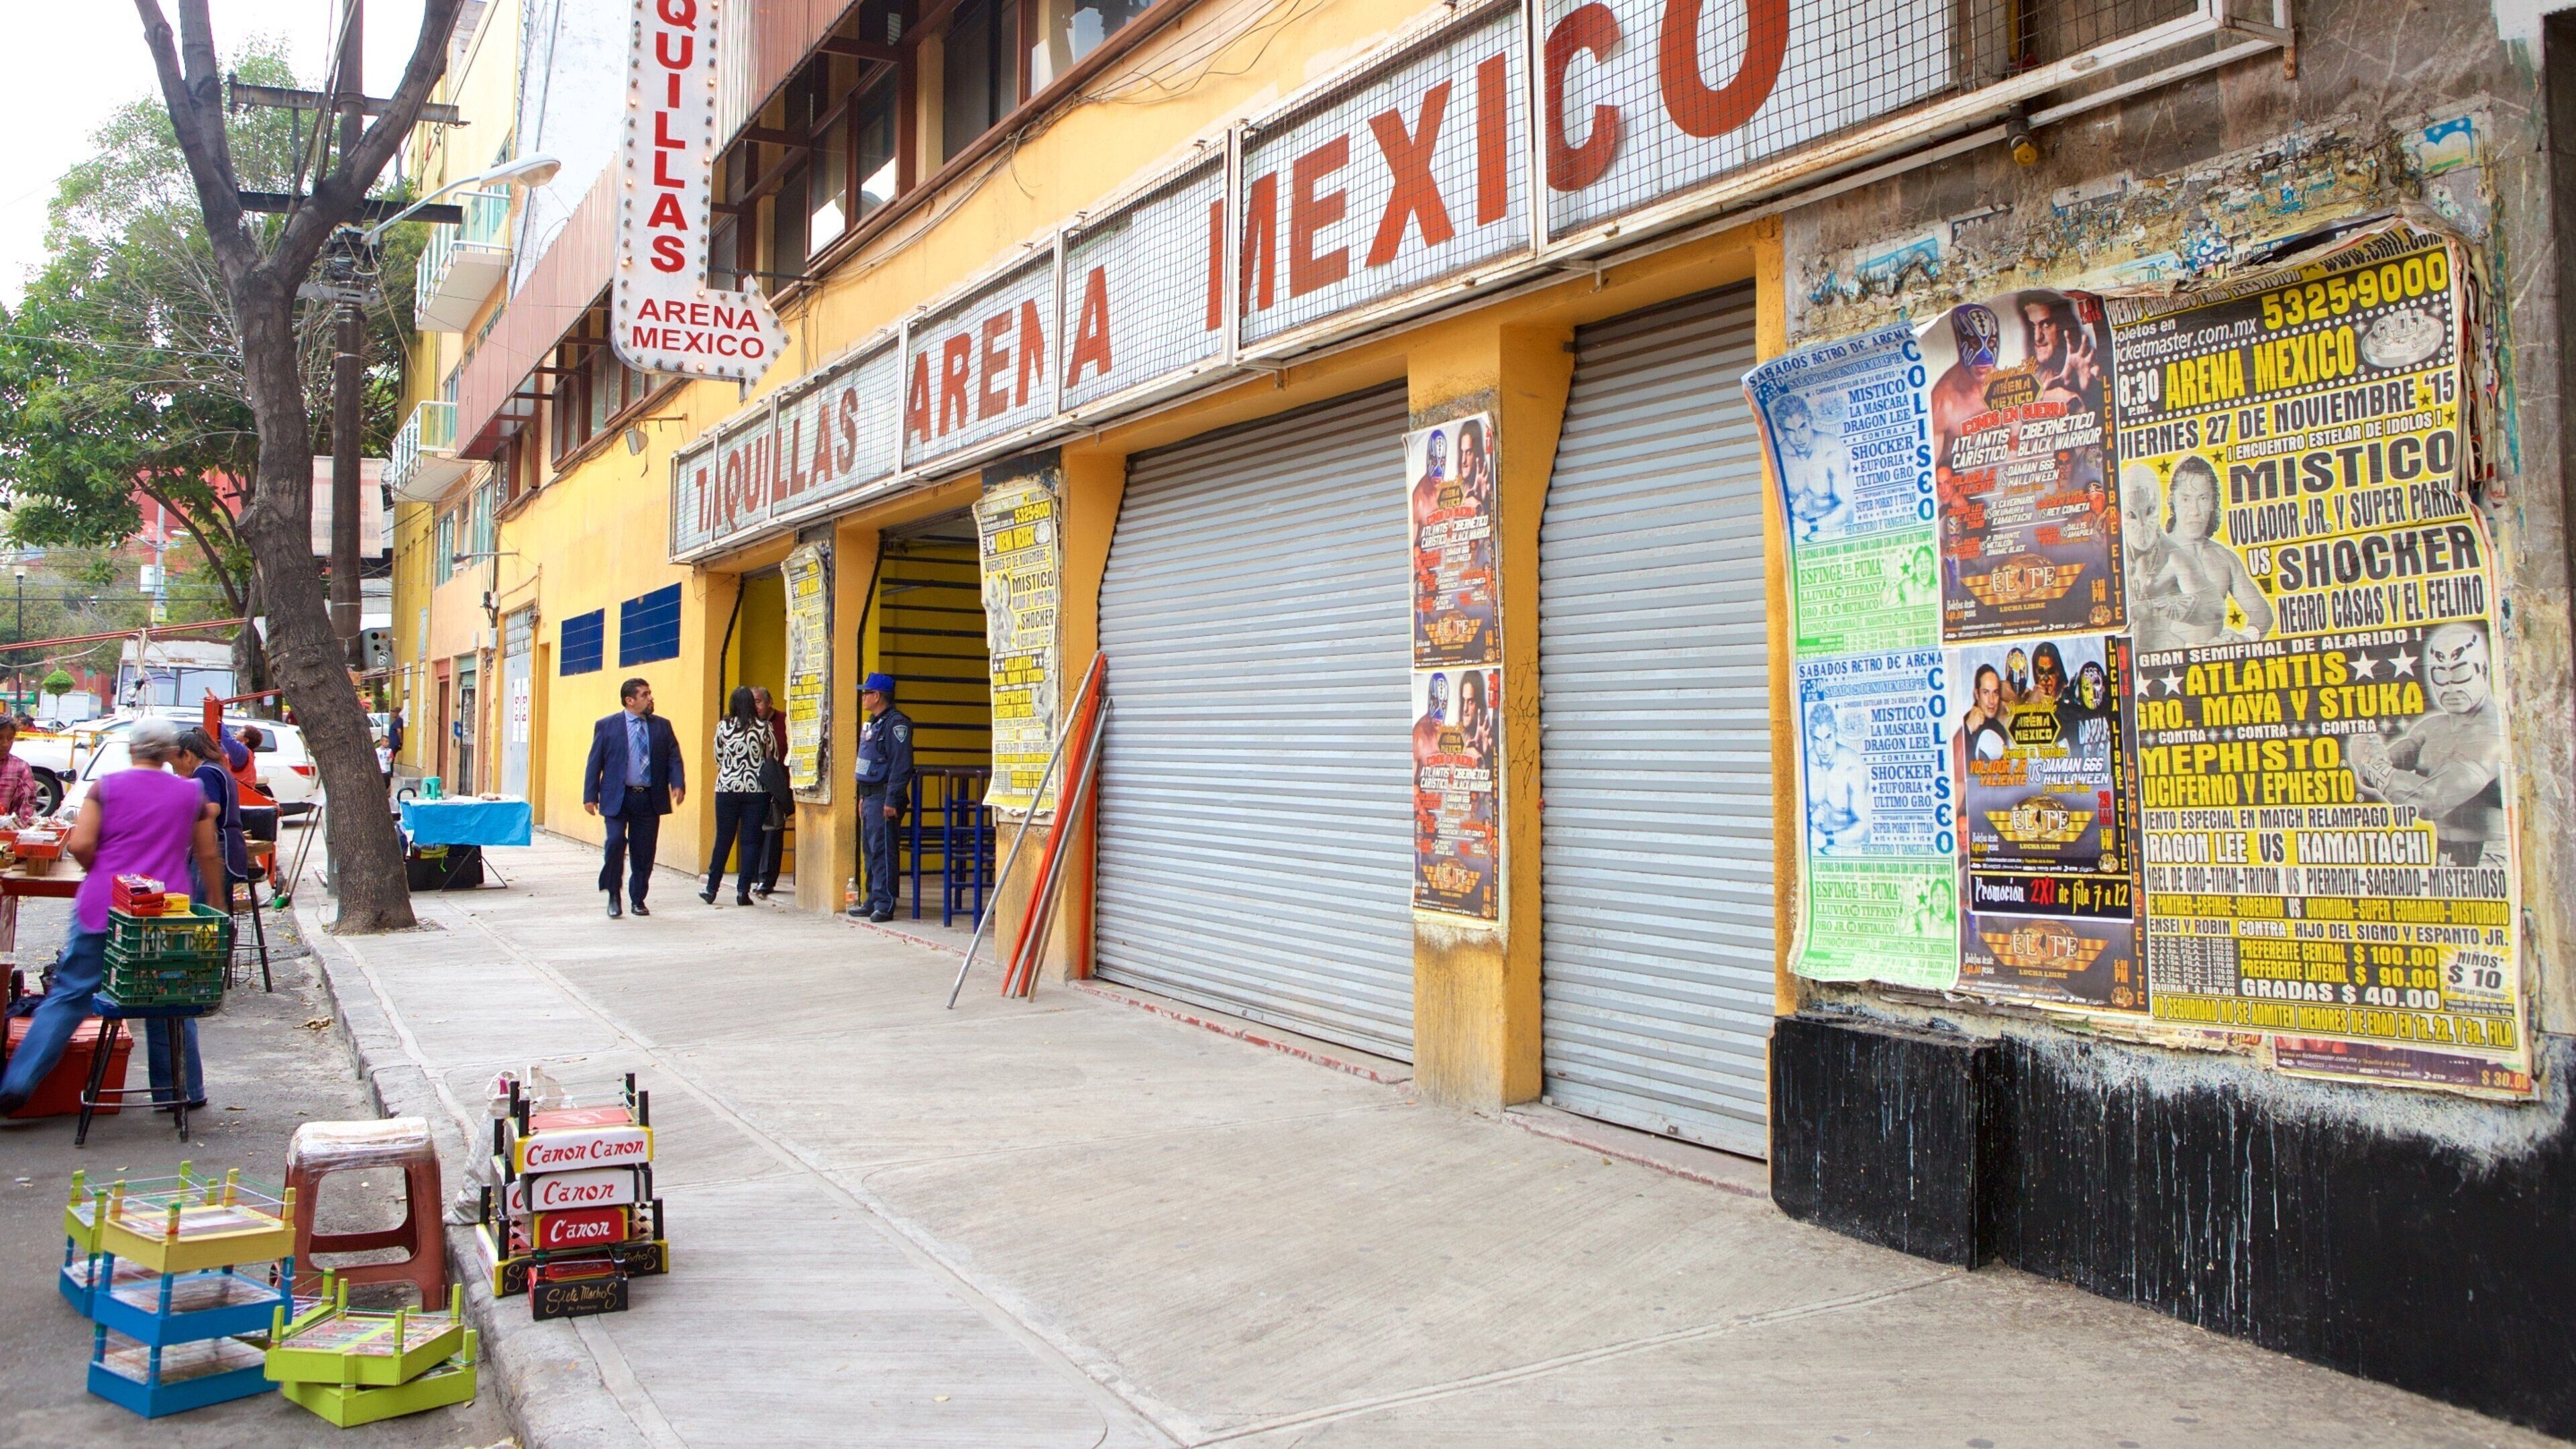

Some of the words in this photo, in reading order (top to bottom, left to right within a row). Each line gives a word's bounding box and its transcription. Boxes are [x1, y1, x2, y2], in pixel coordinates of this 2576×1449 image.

[696, 387, 858, 532] TAQUILLAS
[905, 265, 1111, 451] ARENA
[1207, 0, 1788, 331] MEXICO
[637, 299, 759, 331] ARENA
[2160, 318, 2176, 331] en
[632, 327, 764, 358] MEXICO
[2115, 317, 2257, 364] icketmaster.com.mx
[1748, 356, 1808, 388] SABADOS
[1812, 345, 1847, 364] RETRO
[1850, 339, 1868, 353] DE
[1872, 328, 1912, 347] ARENA
[2119, 368, 2159, 407] 8:30
[2165, 349, 2245, 411] ARENA
[2253, 325, 2356, 393] MEXICO
[1848, 378, 1906, 404] MISTICO
[1991, 390, 2033, 411] MEXICO
[1849, 405, 1862, 419] LA
[1864, 394, 1909, 415] MASCARA
[2002, 406, 2019, 423] EN
[2022, 402, 2067, 420] GUERRA
[2206, 414, 2231, 445] 27
[2238, 406, 2266, 439] DE
[2274, 378, 2416, 432] NOVIEMBRE
[1843, 413, 1888, 433] DRAGON
[1890, 408, 1911, 424] LEE
[1951, 428, 2010, 454] ATLANTIS
[2019, 412, 2095, 441] CIBERNÉTICO
[1862, 428, 1898, 440] CONTRA
[2235, 434, 2305, 462] ENCUENTRO
[2309, 423, 2362, 447] ESTELAR
[2365, 421, 2382, 437] DE
[2385, 411, 2433, 431] IDOLOS
[1851, 437, 1915, 461] SHOCKER
[1952, 444, 2008, 469] CARÍSTICO
[2018, 437, 2051, 457] BLACK
[2055, 427, 2102, 451] WARRIOR
[1860, 454, 1904, 472] EUFORIA
[2229, 430, 2455, 504] MISTICO
[1856, 470, 1891, 487] ULTIMO
[2229, 502, 2298, 546] VOLADOR
[2304, 498, 2326, 536] JR.
[2351, 486, 2406, 529] SUPER
[2410, 480, 2466, 520] PARKA
[996, 530, 1012, 553] ARENA
[1014, 525, 1034, 549] MEXICO
[1421, 523, 1448, 537] ATLANTIS
[2278, 525, 2481, 592] SHOCKER
[1012, 570, 1054, 594] MISTICO
[1800, 563, 1843, 585] ESFINGE
[1855, 559, 1882, 578] PUMA
[1801, 589, 1833, 602] LLUVIA
[2278, 592, 2327, 634] NEGRO
[2332, 586, 2383, 629] CASAS
[2404, 582, 2424, 622] EL
[2426, 574, 2483, 619] FELINO
[1021, 608, 1054, 631] SHOCKER
[2139, 651, 2183, 667] GRAN
[2190, 641, 2286, 663] SEMIFINAL
[2292, 637, 2315, 653] DE
[2318, 629, 2407, 650] ALARIDO
[1005, 655, 1032, 671] ATLANTIS
[1799, 661, 1847, 678] SABADOS
[1851, 657, 1882, 672] RETRO
[1887, 656, 1901, 669] DE
[1907, 651, 1943, 668] ARENA
[2186, 651, 2347, 696] ATLANTIS
[994, 690, 1030, 704] MEPHISTO
[1801, 678, 1823, 694] 7:30
[1871, 706, 1925, 722] MISTICO
[2202, 692, 2281, 727] MAYA
[2290, 690, 2308, 721] Y
[2319, 682, 2424, 718] STUKA
[2017, 716, 2050, 727] ARENA
[2158, 730, 2206, 744] CONTRA
[2237, 724, 2288, 740] CONTRA
[2321, 718, 2377, 735] CONTRA
[2015, 729, 2053, 741] MEXICO
[1970, 759, 2011, 775] VOLADOR
[2043, 759, 2080, 771] DAMIAN
[2141, 737, 2340, 775] MEPHISTO
[1420, 767, 1449, 777] ATLANTIS
[1871, 765, 1933, 780] SHOCKER
[1980, 774, 2028, 786] VALIENTE
[2043, 773, 2109, 785] HALLOWEEN
[2143, 774, 2237, 807] UCIFERNO
[2262, 769, 2355, 804] EPHESTO
[2181, 809, 2236, 829] ESPECIAL
[2241, 809, 2255, 829] EN
[2259, 808, 2303, 828] MATCH
[2308, 806, 2390, 828] RELAMPAGO
[2393, 806, 2416, 827] VIP
[2147, 833, 2209, 863] RAGON
[2215, 833, 2249, 863] LEE
[2259, 833, 2284, 863] VS
[2297, 830, 2430, 864] KAMAITACHI
[1815, 881, 1858, 898] ESFINGE
[1872, 883, 1898, 900] PUMA
[2186, 867, 2279, 894] ORO-TITAN-TRITON
[2285, 868, 2300, 895] VS
[2306, 868, 2507, 898] PIERROTH-SAGRADO-MISTERIOSO
[2058, 883, 2070, 904] de
[2073, 879, 2090, 914] fila
[2094, 886, 2101, 912] 7
[2105, 892, 2111, 906] a
[2114, 883, 2128, 907] 12
[2288, 898, 2301, 918] VS
[2195, 920, 2231, 934] ROBIN
[2238, 920, 2286, 938] CONTRA
[2295, 923, 2324, 938] HIJO
[2330, 924, 2352, 940] DEL
[2357, 924, 2398, 941] SIGNO
[2416, 927, 2479, 945] ESPANTO
[2485, 929, 2509, 946] JR.
[2239, 940, 2299, 961] PREFERENTE
[2302, 943, 2347, 963] CENTRAL
[2370, 947, 2436, 967] 100.00
[2241, 959, 2302, 980] PREFERENTE
[2305, 963, 2349, 983] LATERAL
[2379, 967, 2437, 989] 90.00
[2473, 969, 2502, 989] 10
[2241, 979, 2334, 1002] GRADAS
[2365, 987, 2440, 1010] 40.00
[2166, 997, 2218, 1022] SEGURIDAD
[2220, 1000, 2235, 1024] NO
[2236, 1002, 2249, 1024] SE
[2251, 1003, 2296, 1028] ADMITEN
[2297, 1007, 2349, 1034] MENORES
[2350, 1010, 2365, 1034] DE
[2367, 1012, 2396, 1036] EDAD
[2398, 1013, 2413, 1038] EN
[2487, 1020, 2514, 1047] FILA
[526, 1144, 586, 1167] Canon
[590, 1140, 645, 1159] Canon
[543, 1181, 614, 1205] Canon
[550, 1220, 611, 1242] Canon
